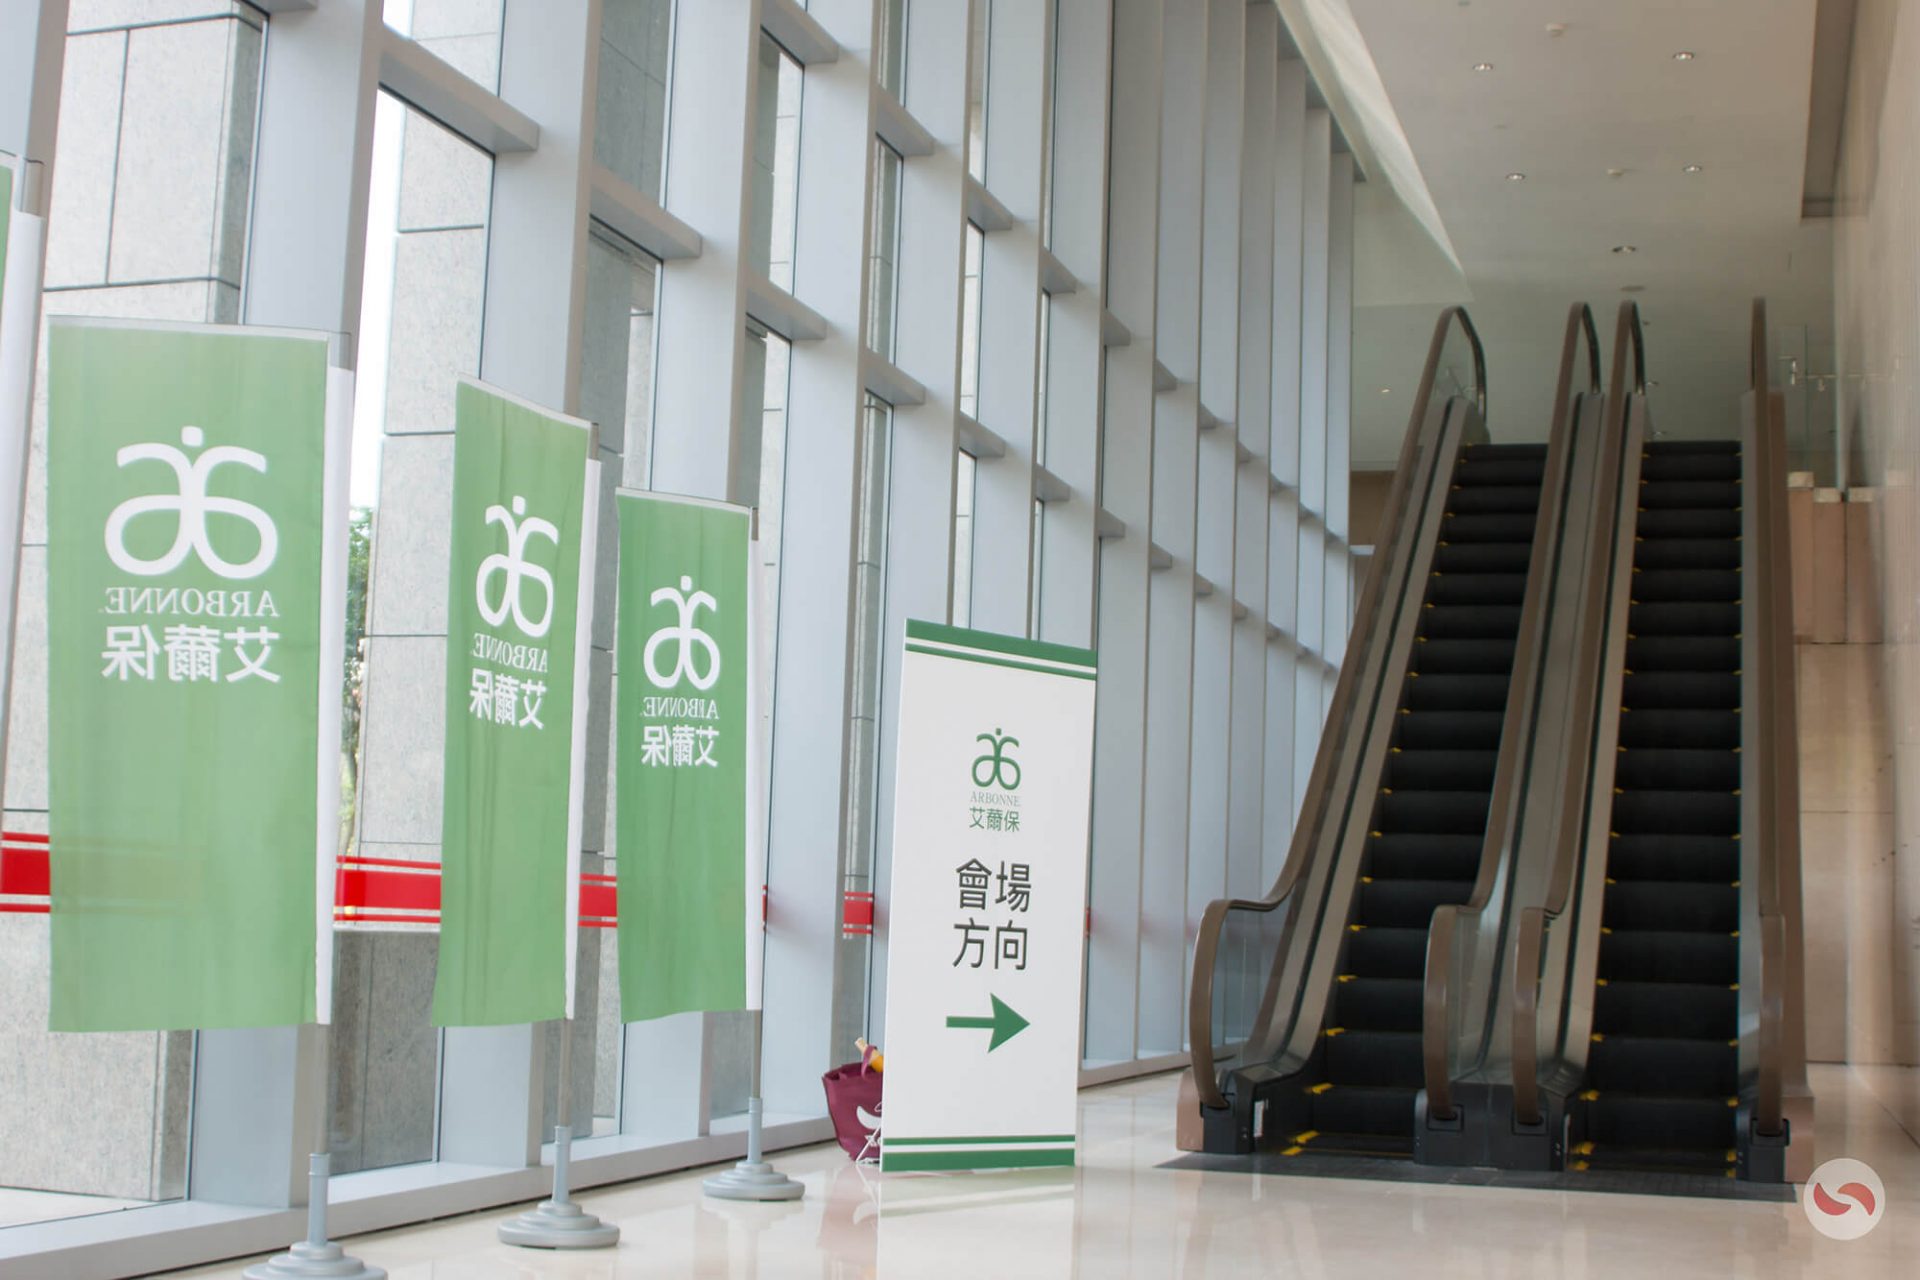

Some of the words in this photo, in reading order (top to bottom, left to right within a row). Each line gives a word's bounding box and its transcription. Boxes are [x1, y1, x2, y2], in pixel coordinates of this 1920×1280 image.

[970, 791, 1021, 807] ARBONNE
[956, 858, 1032, 913] 會場
[952, 917, 1028, 971] 方向
